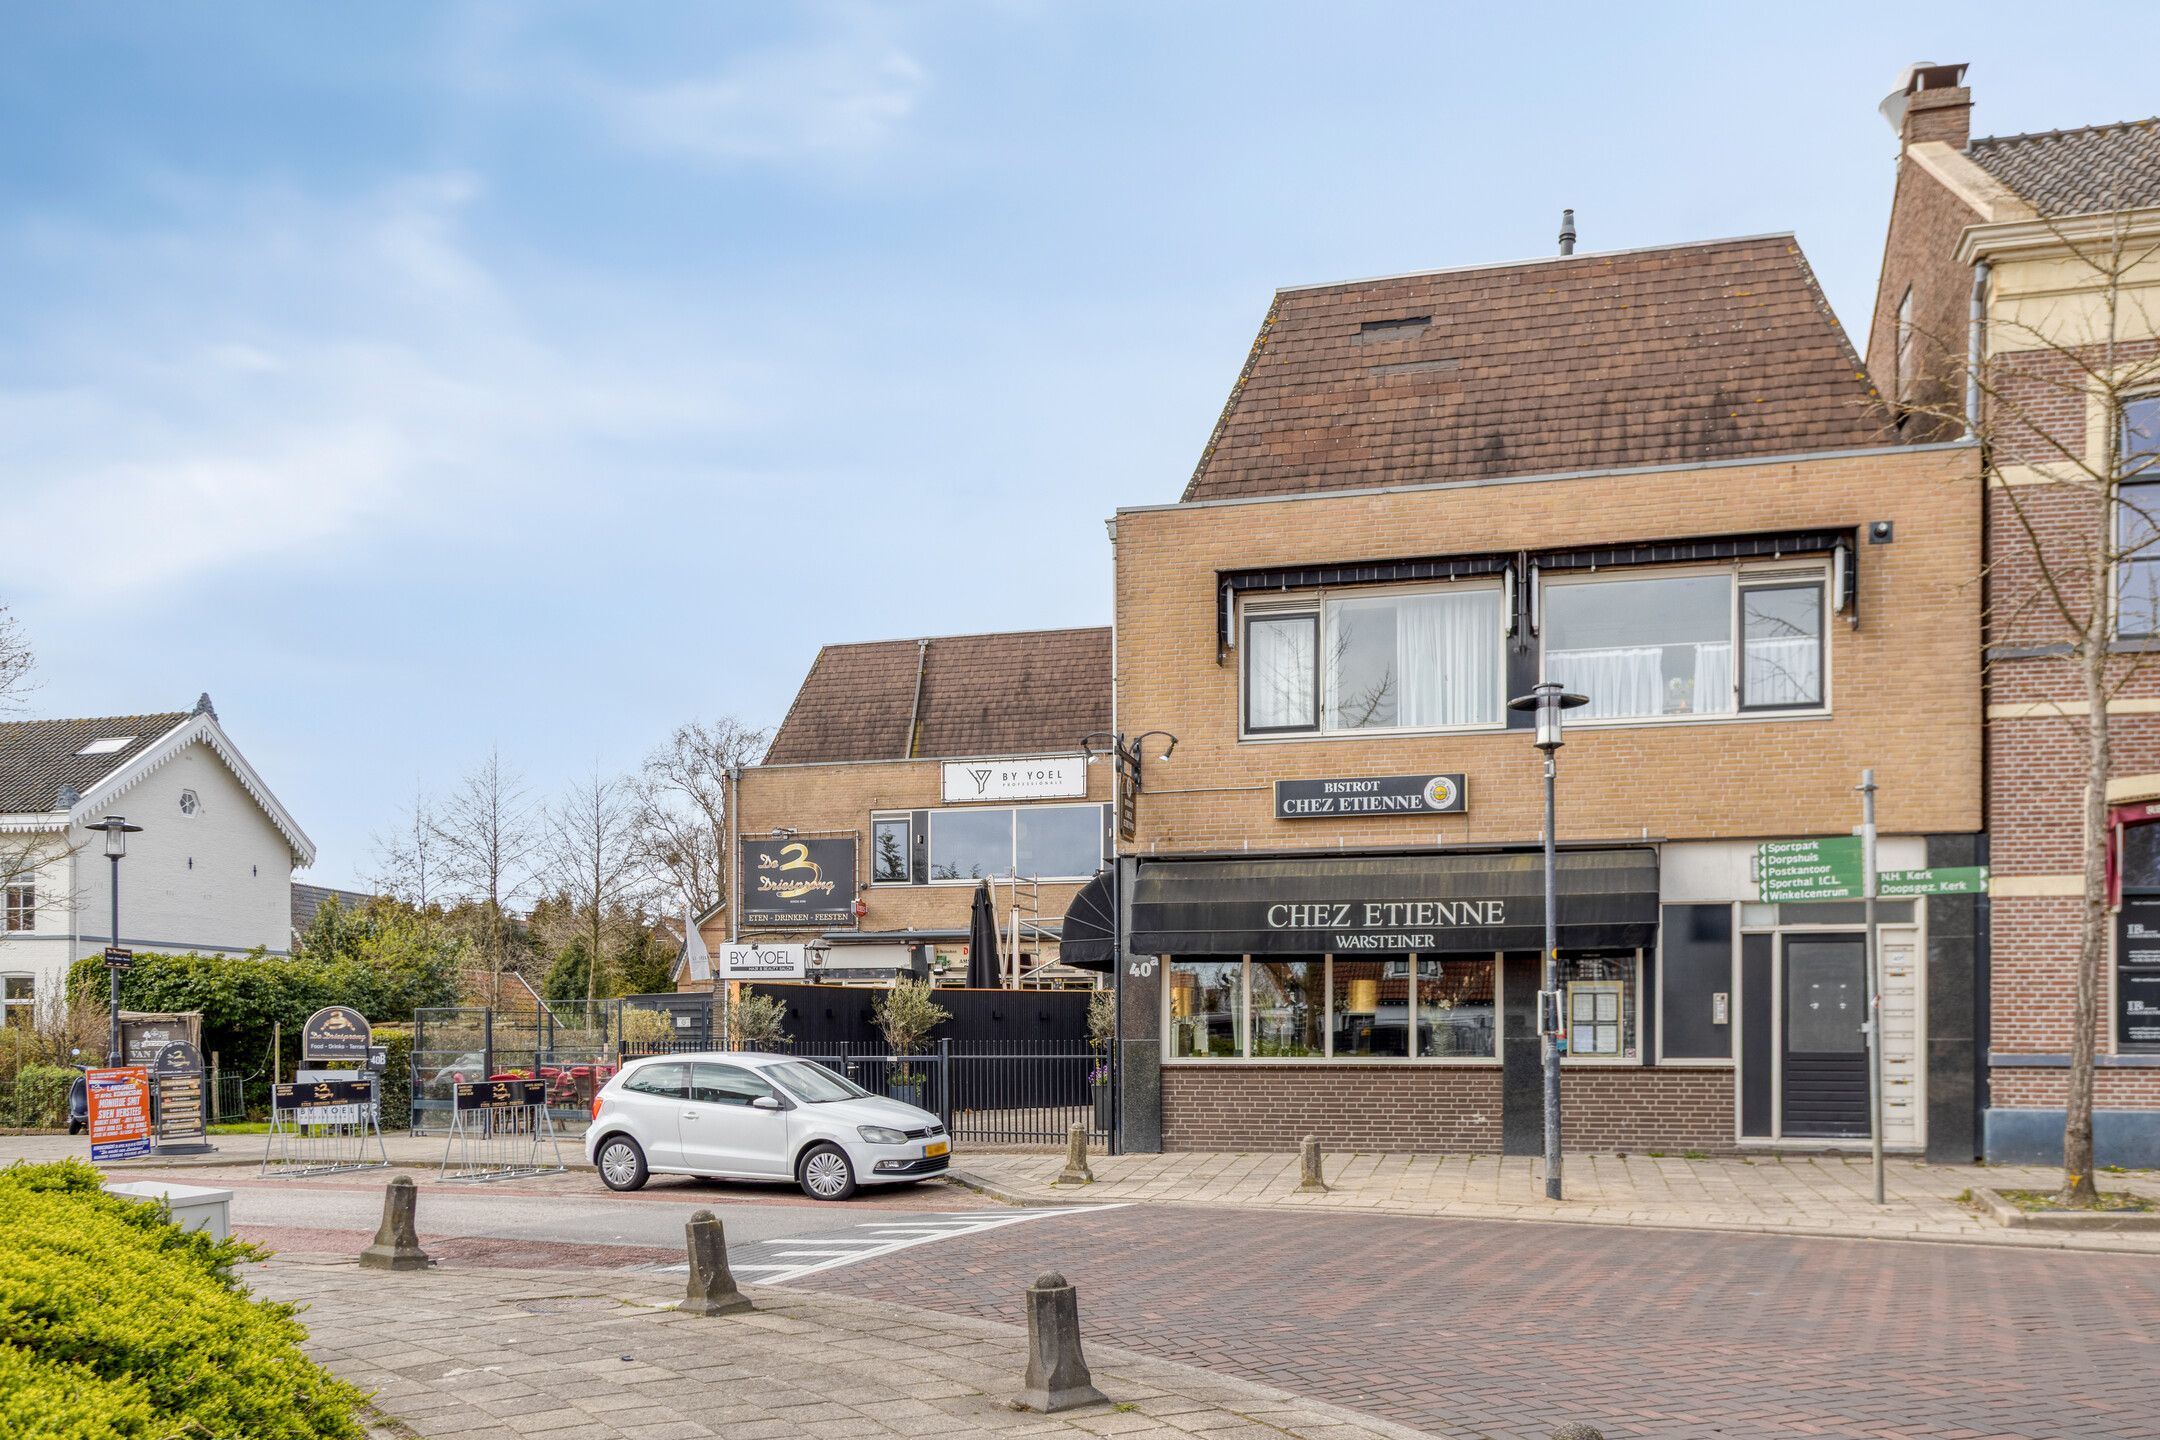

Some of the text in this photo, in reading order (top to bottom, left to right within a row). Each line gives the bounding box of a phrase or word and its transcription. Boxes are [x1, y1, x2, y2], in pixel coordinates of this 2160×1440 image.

[1002, 770, 1062, 781] BY YOEL
[1324, 781, 1380, 793] BISTROT
[1283, 795, 1423, 813] CHEZ ETIENNE
[1767, 841, 1819, 854] Sportpark
[758, 853, 779, 869] De
[1768, 853, 1819, 865] Dorpshuis
[1768, 865, 1831, 876] Postkantoor
[1907, 871, 1933, 880] Kerk
[757, 876, 835, 895] Driesprong
[1769, 877, 1813, 889] Sporthal
[1940, 881, 1967, 891] Kerk
[1769, 888, 1849, 900] Winkelcentrum
[749, 914, 769, 922] ETEN
[815, 913, 848, 921] FEESTEN
[1267, 900, 1506, 928] CHEZ ETIENNE
[1335, 934, 1435, 949] WARSTEINER
[730, 950, 794, 965] BY YOEL
